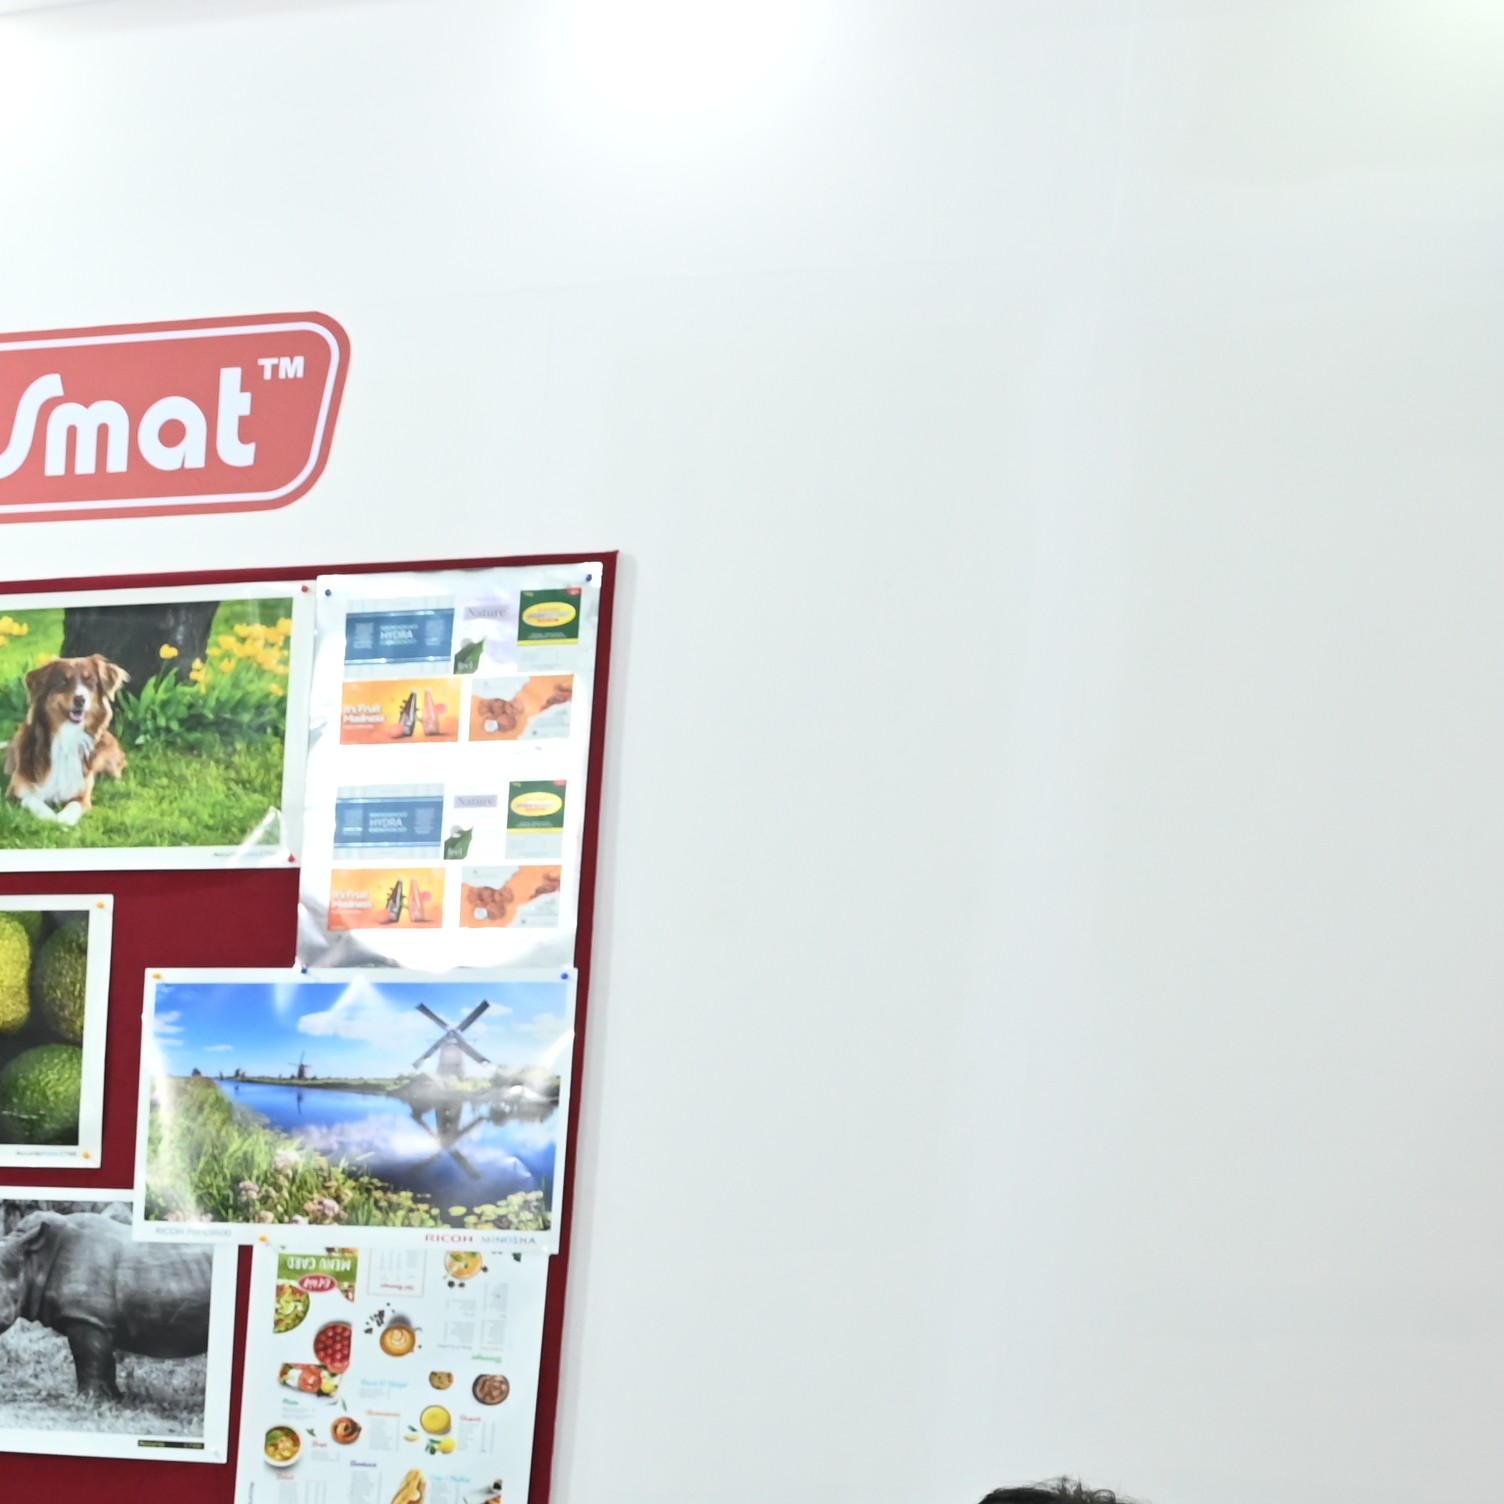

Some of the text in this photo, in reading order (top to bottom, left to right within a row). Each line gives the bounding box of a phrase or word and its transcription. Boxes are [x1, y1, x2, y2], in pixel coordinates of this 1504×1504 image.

[466, 605, 507, 618] Nature
[425, 1233, 474, 1244] RICOH
[287, 1255, 351, 1271] MENU CARD
